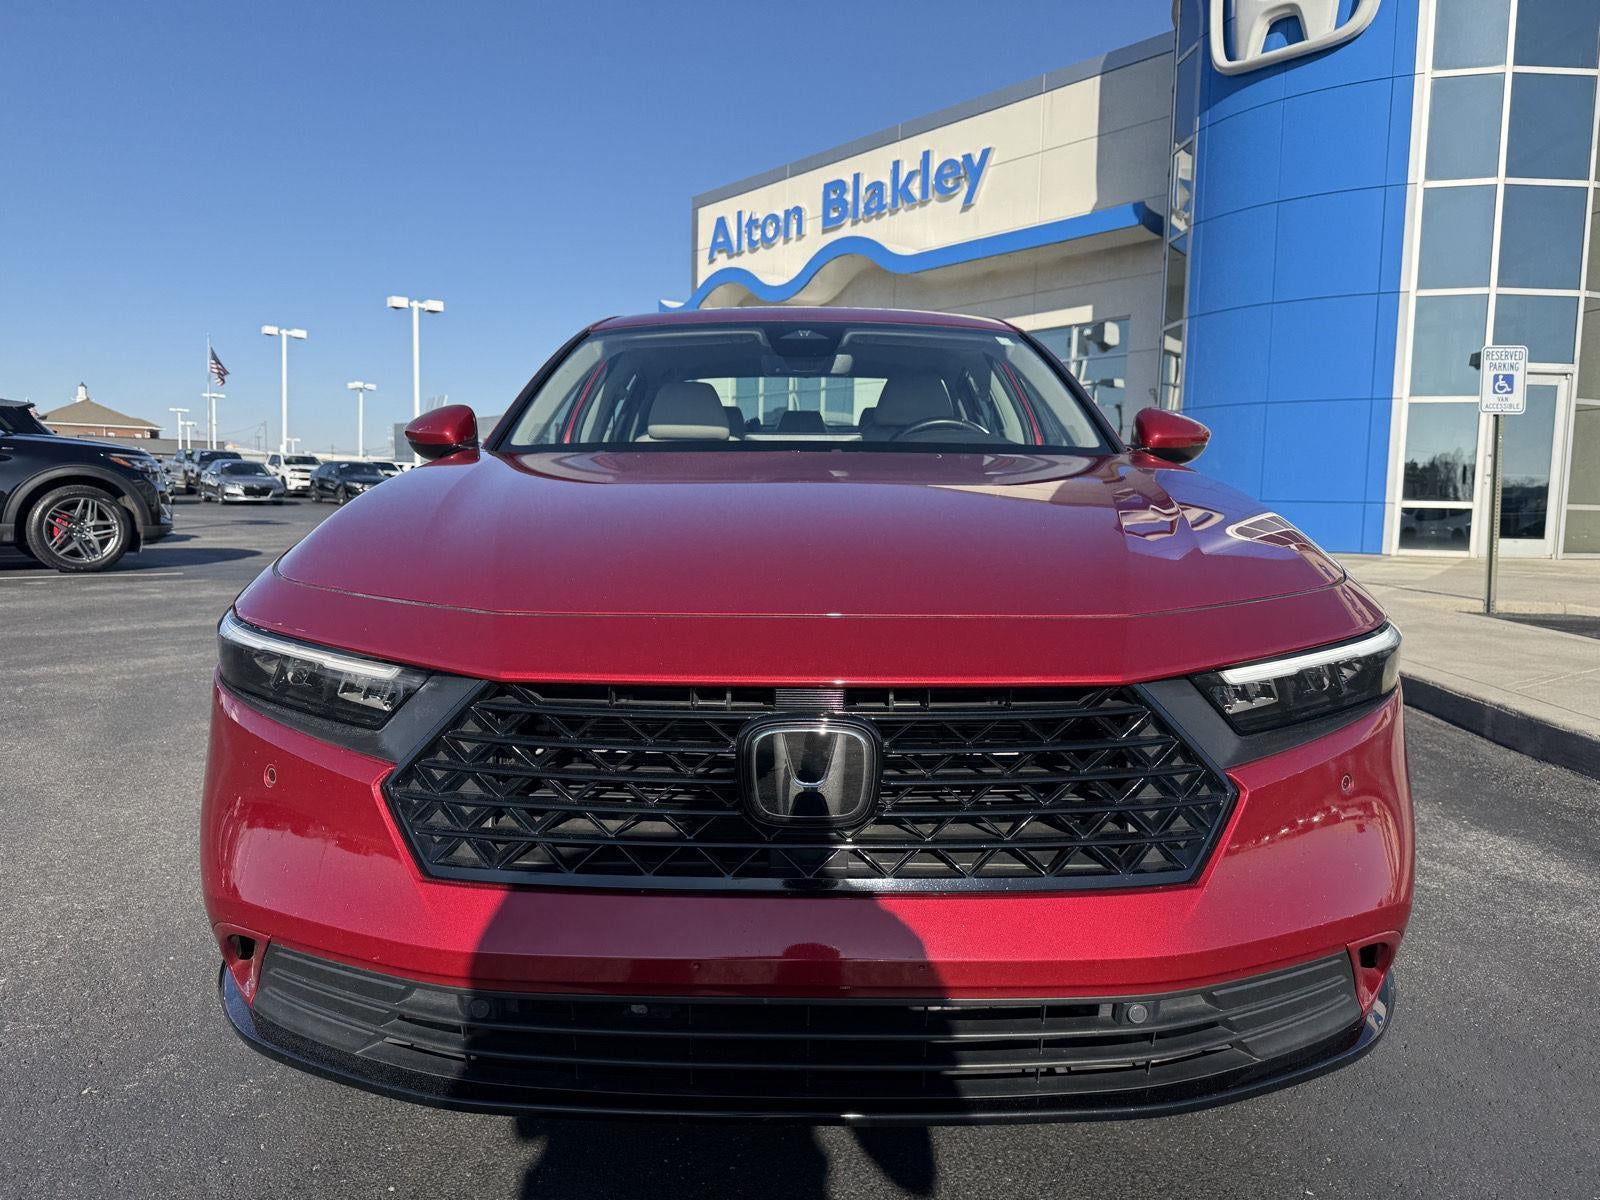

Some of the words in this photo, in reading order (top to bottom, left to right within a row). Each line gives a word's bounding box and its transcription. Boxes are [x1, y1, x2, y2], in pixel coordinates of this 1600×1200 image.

[707, 205, 805, 263] Alton
[821, 147, 994, 232] Blakley
[1485, 350, 1524, 361] RESERVED
[1488, 362, 1520, 372] PARKING
